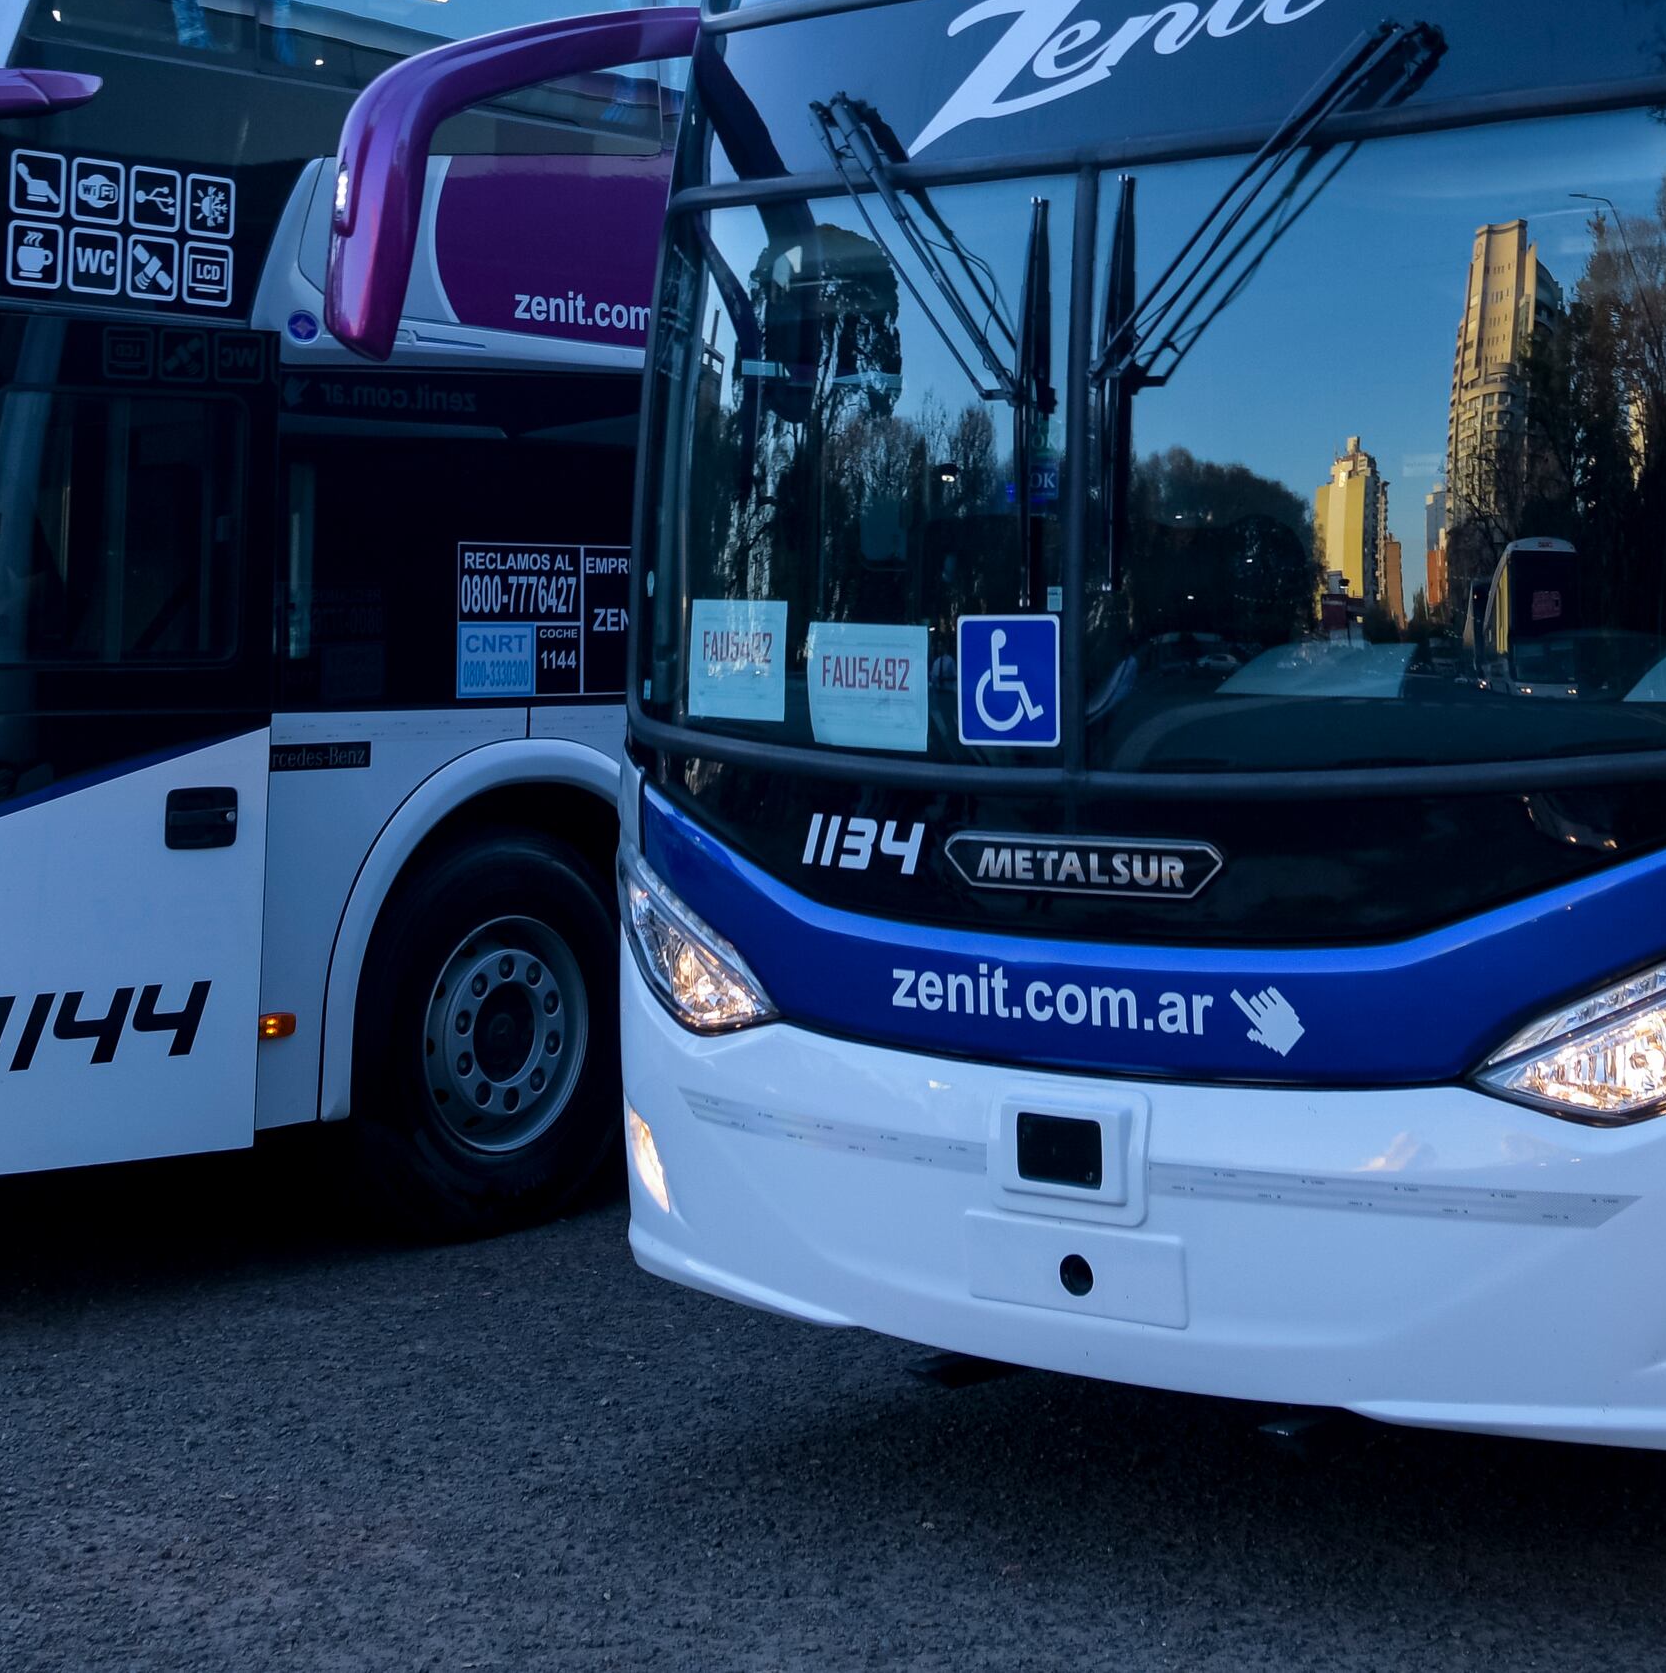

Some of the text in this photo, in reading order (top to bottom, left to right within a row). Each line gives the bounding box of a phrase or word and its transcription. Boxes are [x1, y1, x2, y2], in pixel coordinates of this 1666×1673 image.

[76, 246, 115, 276] WC
[196, 262, 221, 281] LCD
[464, 552, 574, 570] RECLAMOS AL
[461, 575, 577, 613] 0800-7776427
[465, 634, 528, 653] CNRT
[539, 629, 578, 638] COCHE
[540, 650, 576, 669] 1144
[822, 654, 910, 691] FAU5492
[802, 813, 925, 875] 1134
[976, 846, 1184, 889] METALSUR
[892, 963, 1214, 1036] zenit.com.ar
